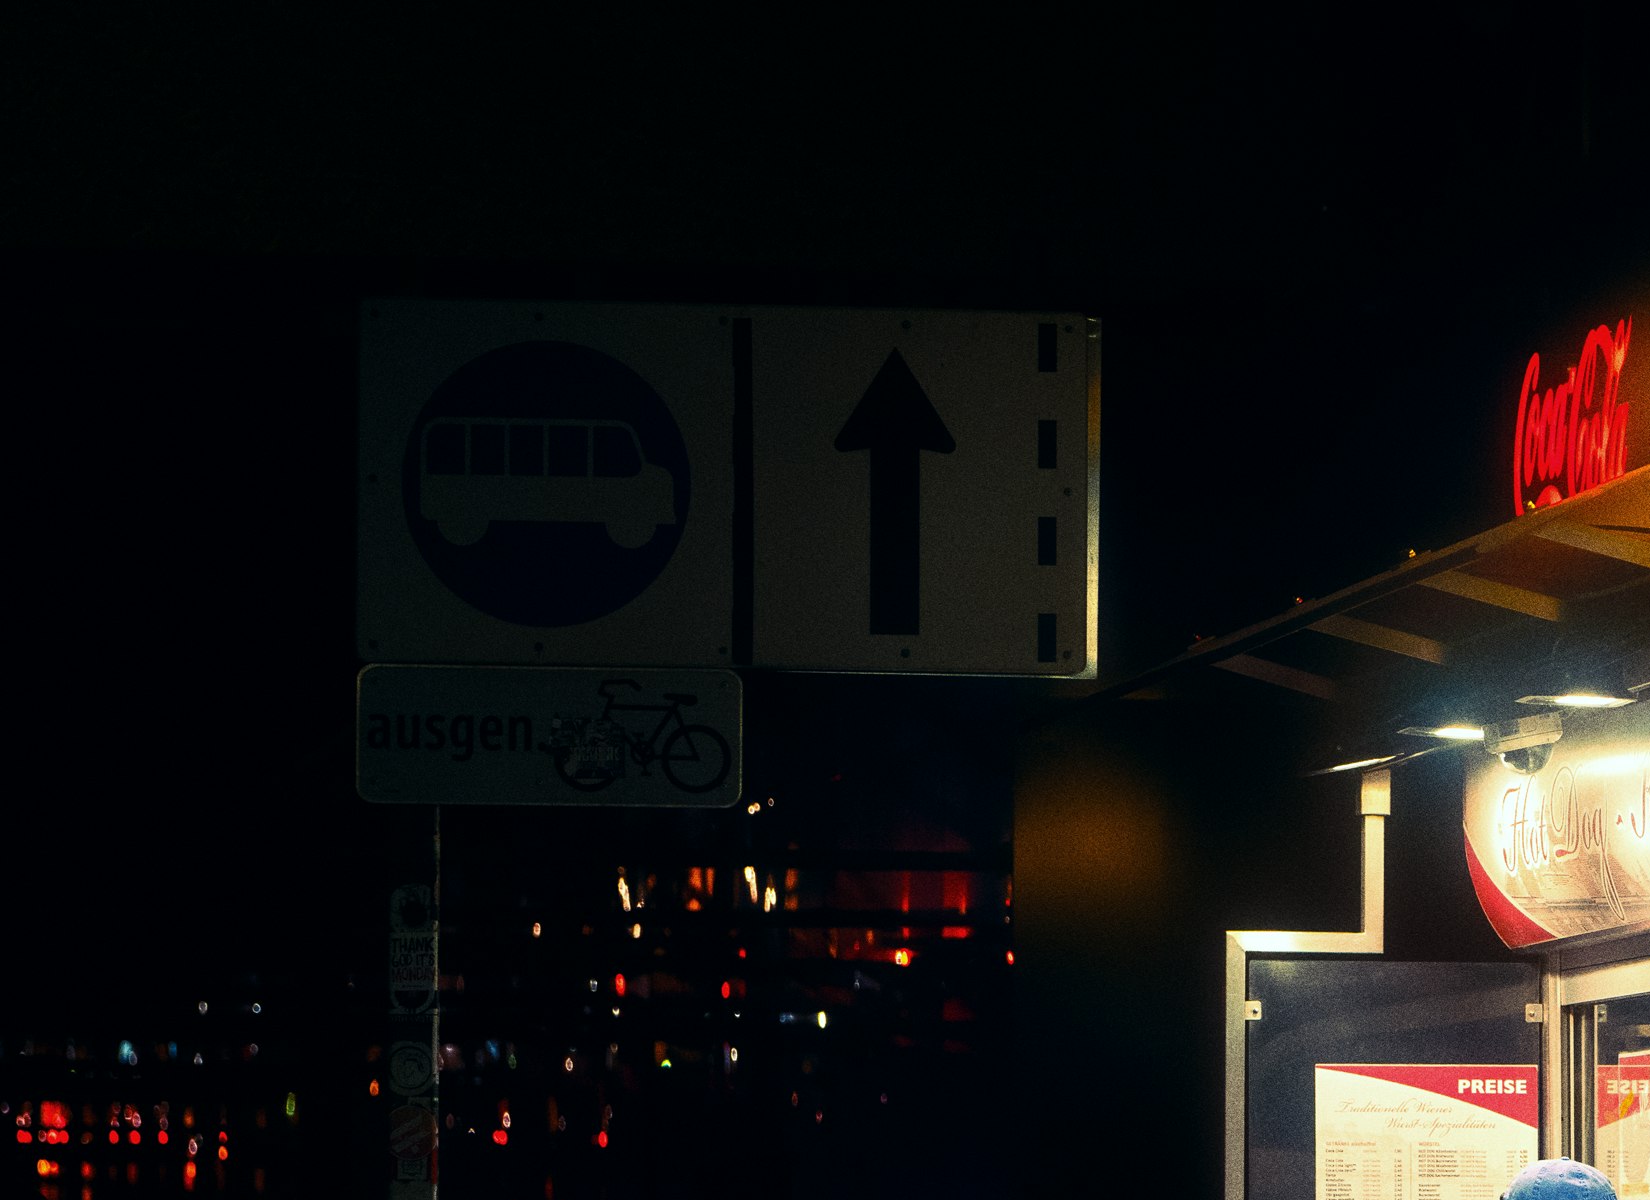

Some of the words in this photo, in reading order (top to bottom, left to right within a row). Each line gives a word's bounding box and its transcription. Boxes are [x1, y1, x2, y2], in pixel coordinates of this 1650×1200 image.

[367, 713, 549, 762] ausgen.
[1502, 774, 1548, 872] Hot
[1457, 1079, 1528, 1095] PREISE
